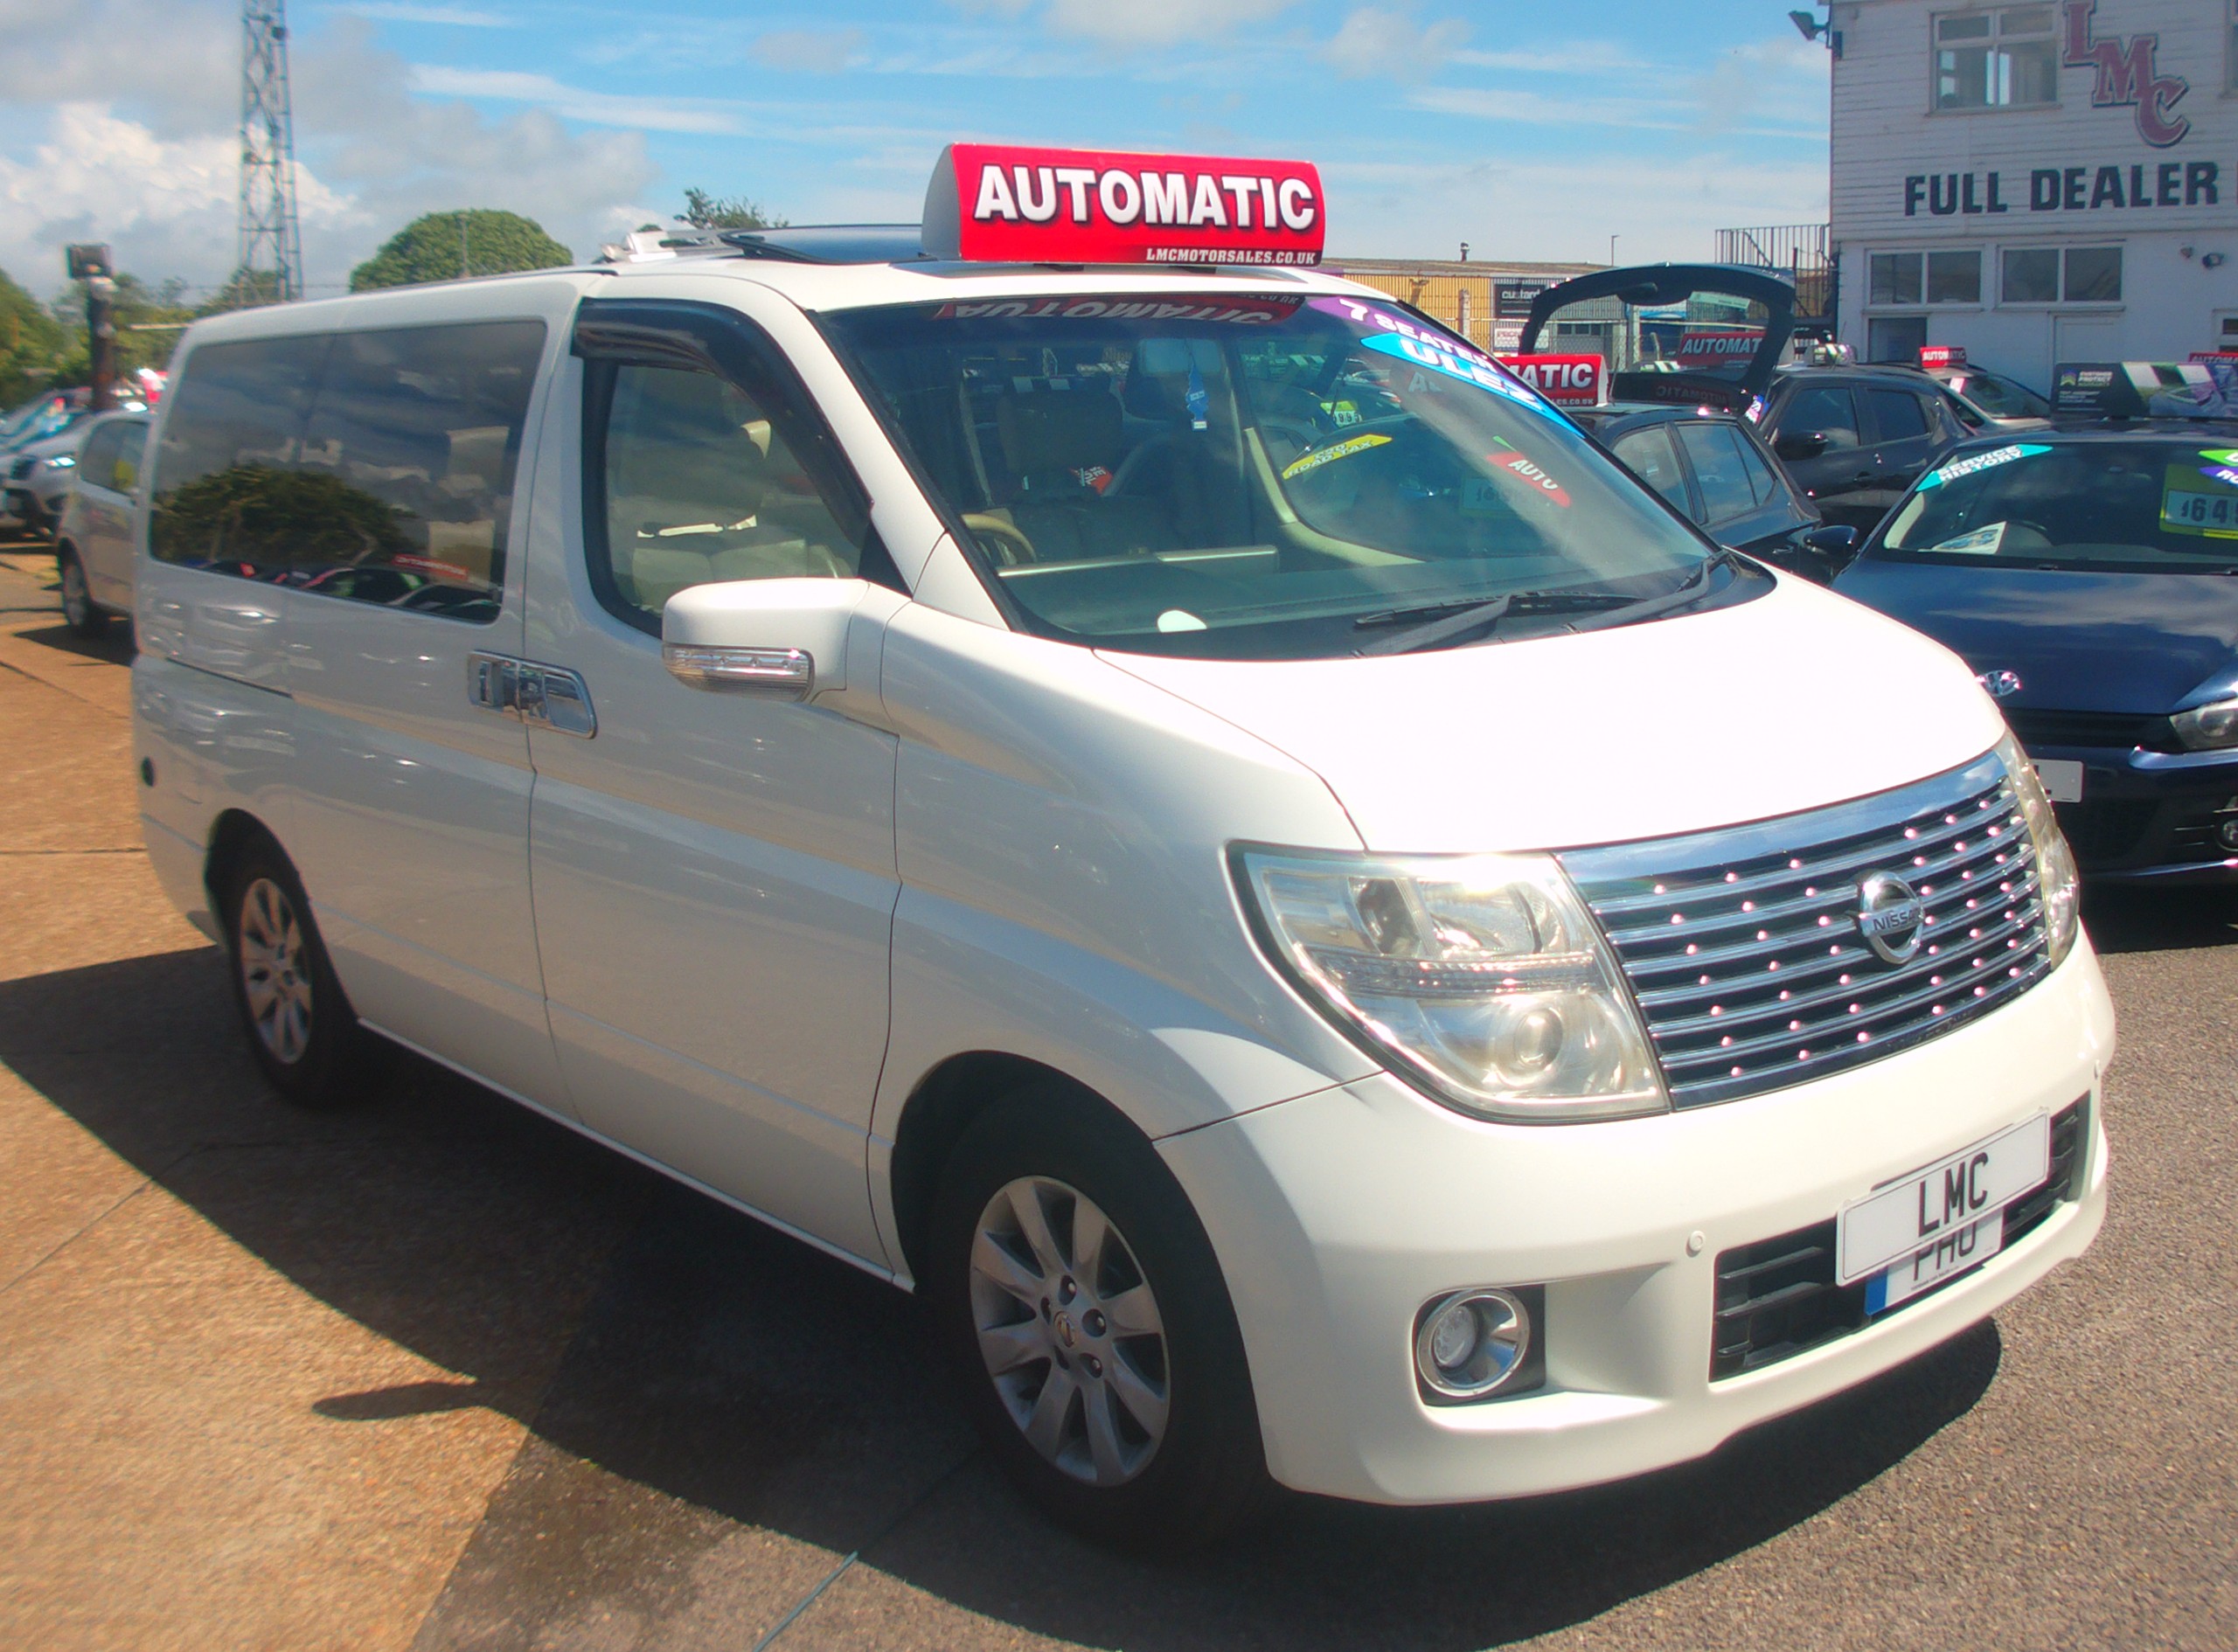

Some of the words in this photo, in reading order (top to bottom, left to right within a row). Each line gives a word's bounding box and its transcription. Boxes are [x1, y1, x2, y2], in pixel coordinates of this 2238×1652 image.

[2063, 0, 2191, 148] LMC
[974, 164, 1315, 231] AUTOMATIC
[1905, 171, 2008, 216] FULL
[2031, 162, 2220, 212] DEALER
[1146, 247, 1316, 265] LMCMOTORSALES.CO.UK
[1339, 298, 1368, 322] 7
[1374, 313, 1498, 374] SEATER
[1922, 350, 1966, 361] AUTOMATIC
[1400, 338, 1546, 413] ULEZ
[1936, 444, 2021, 475] SERVICE
[1939, 450, 2023, 481] HISTORY
[1918, 1152, 1989, 1238] LMC
